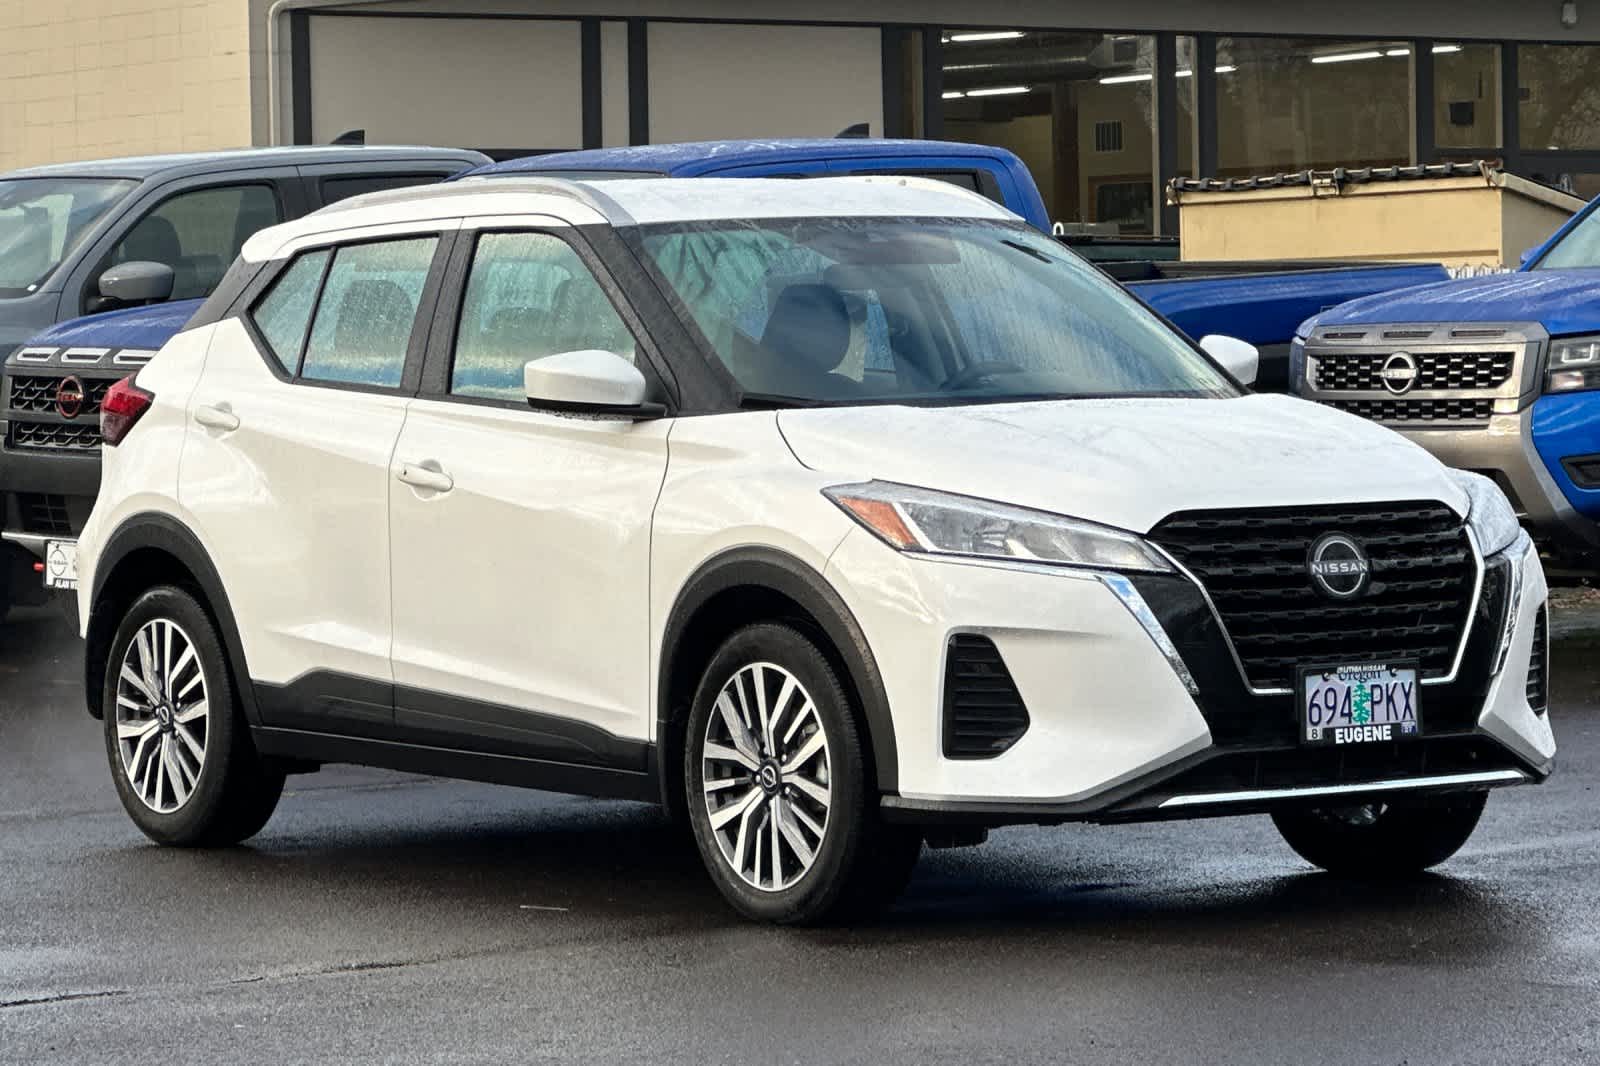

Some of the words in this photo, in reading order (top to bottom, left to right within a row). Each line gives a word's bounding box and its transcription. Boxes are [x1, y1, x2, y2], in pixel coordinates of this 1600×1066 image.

[1311, 562, 1368, 573] NISSAN
[1308, 685, 1353, 726] 694
[1370, 681, 1414, 723] PKX
[1335, 725, 1392, 744] EUGENE
